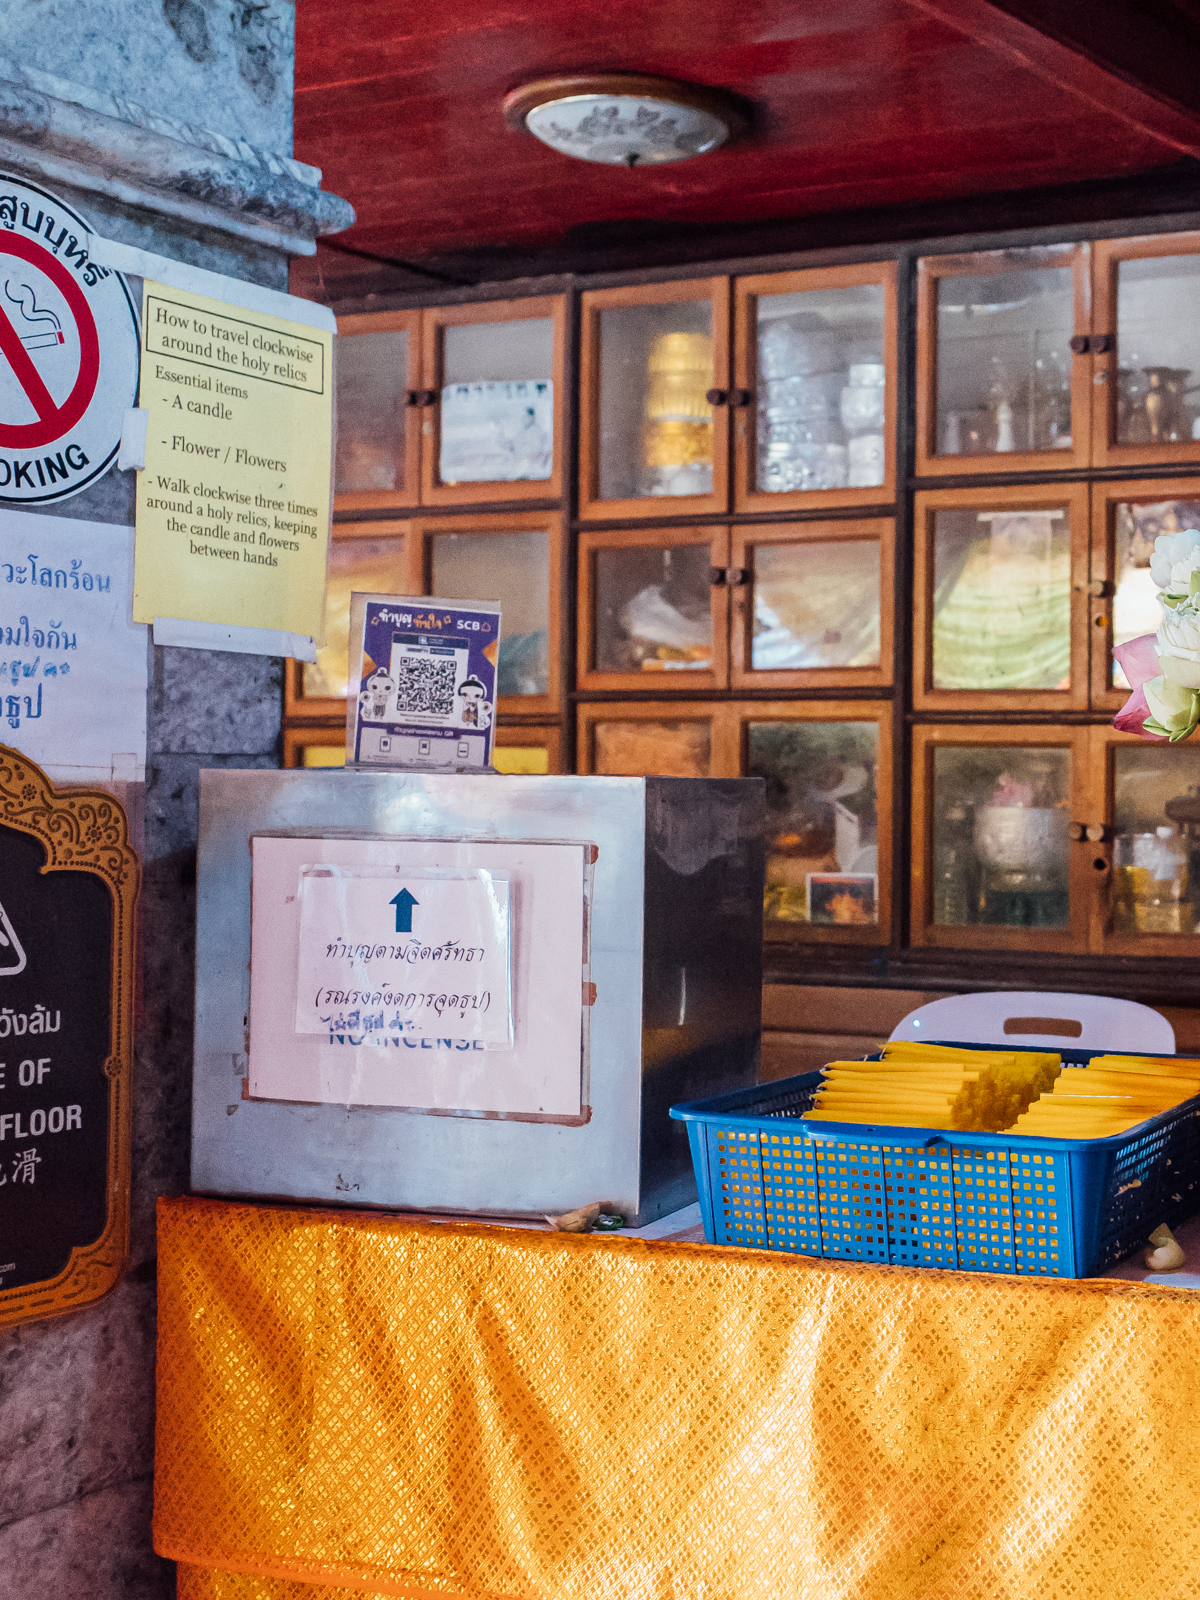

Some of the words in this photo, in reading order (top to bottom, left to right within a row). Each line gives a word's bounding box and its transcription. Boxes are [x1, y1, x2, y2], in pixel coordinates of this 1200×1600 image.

[0, 195, 112, 287] สูบบุหร
[156, 307, 190, 330] How
[194, 319, 207, 335] to
[211, 324, 249, 346] travel
[252, 332, 314, 363] clockwise
[162, 335, 212, 358] around
[217, 346, 238, 364] the
[242, 351, 270, 376] holy
[273, 362, 307, 382] relics
[155, 364, 212, 391] Essential
[215, 378, 249, 400] items
[172, 394, 183, 410] A
[187, 399, 233, 421] candle
[0, 444, 90, 488] OKING
[172, 435, 221, 459] Flower
[235, 448, 287, 472] Flowers
[156, 475, 190, 494] Walk
[193, 482, 251, 505] clockwise
[254, 493, 285, 512] three
[287, 500, 318, 517] times
[146, 497, 193, 515] around
[196, 505, 203, 516] a
[207, 503, 233, 524] holy
[236, 510, 271, 530] relics,
[274, 515, 318, 539] keeping
[167, 517, 187, 534] the
[190, 522, 230, 540] candle
[233, 530, 255, 545] and
[259, 531, 300, 551] flowers
[190, 540, 240, 561] between
[243, 549, 278, 567] hands
[456, 619, 480, 631] SCB
[0, 682, 42, 729] ธูป
[19, 1058, 52, 1087] OF
[0, 1104, 83, 1141] FLOOR
